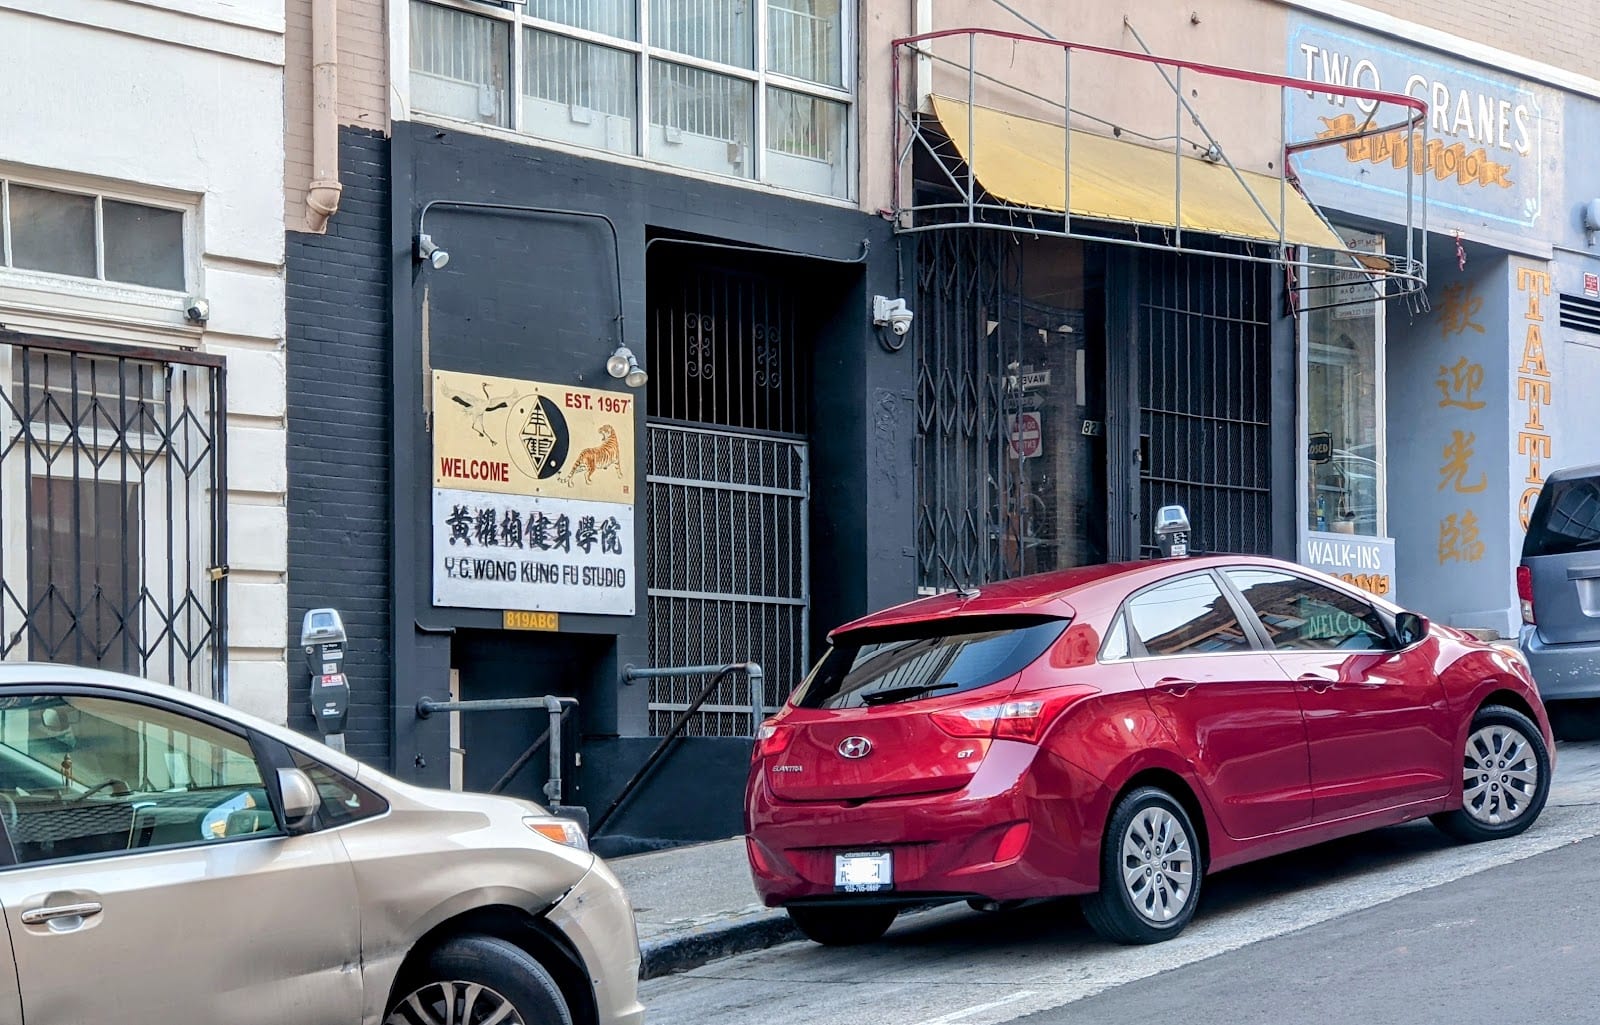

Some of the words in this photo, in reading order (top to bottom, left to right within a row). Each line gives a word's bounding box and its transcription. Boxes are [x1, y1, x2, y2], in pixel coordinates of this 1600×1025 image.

[1300, 43, 1381, 113] TWO
[1404, 74, 1530, 156] CRANES
[565, 392, 593, 410] EST.
[597, 396, 628, 414] 1967
[1517, 267, 1551, 535] TATT
[440, 457, 509, 482] WELCOME
[1307, 541, 1381, 571] WALK-INS
[521, 562, 559, 584] KUNG
[563, 565, 579, 586] FU
[583, 566, 626, 589] STUDIO
[506, 612, 555, 629] 819ABC
[957, 749, 974, 759] GT
